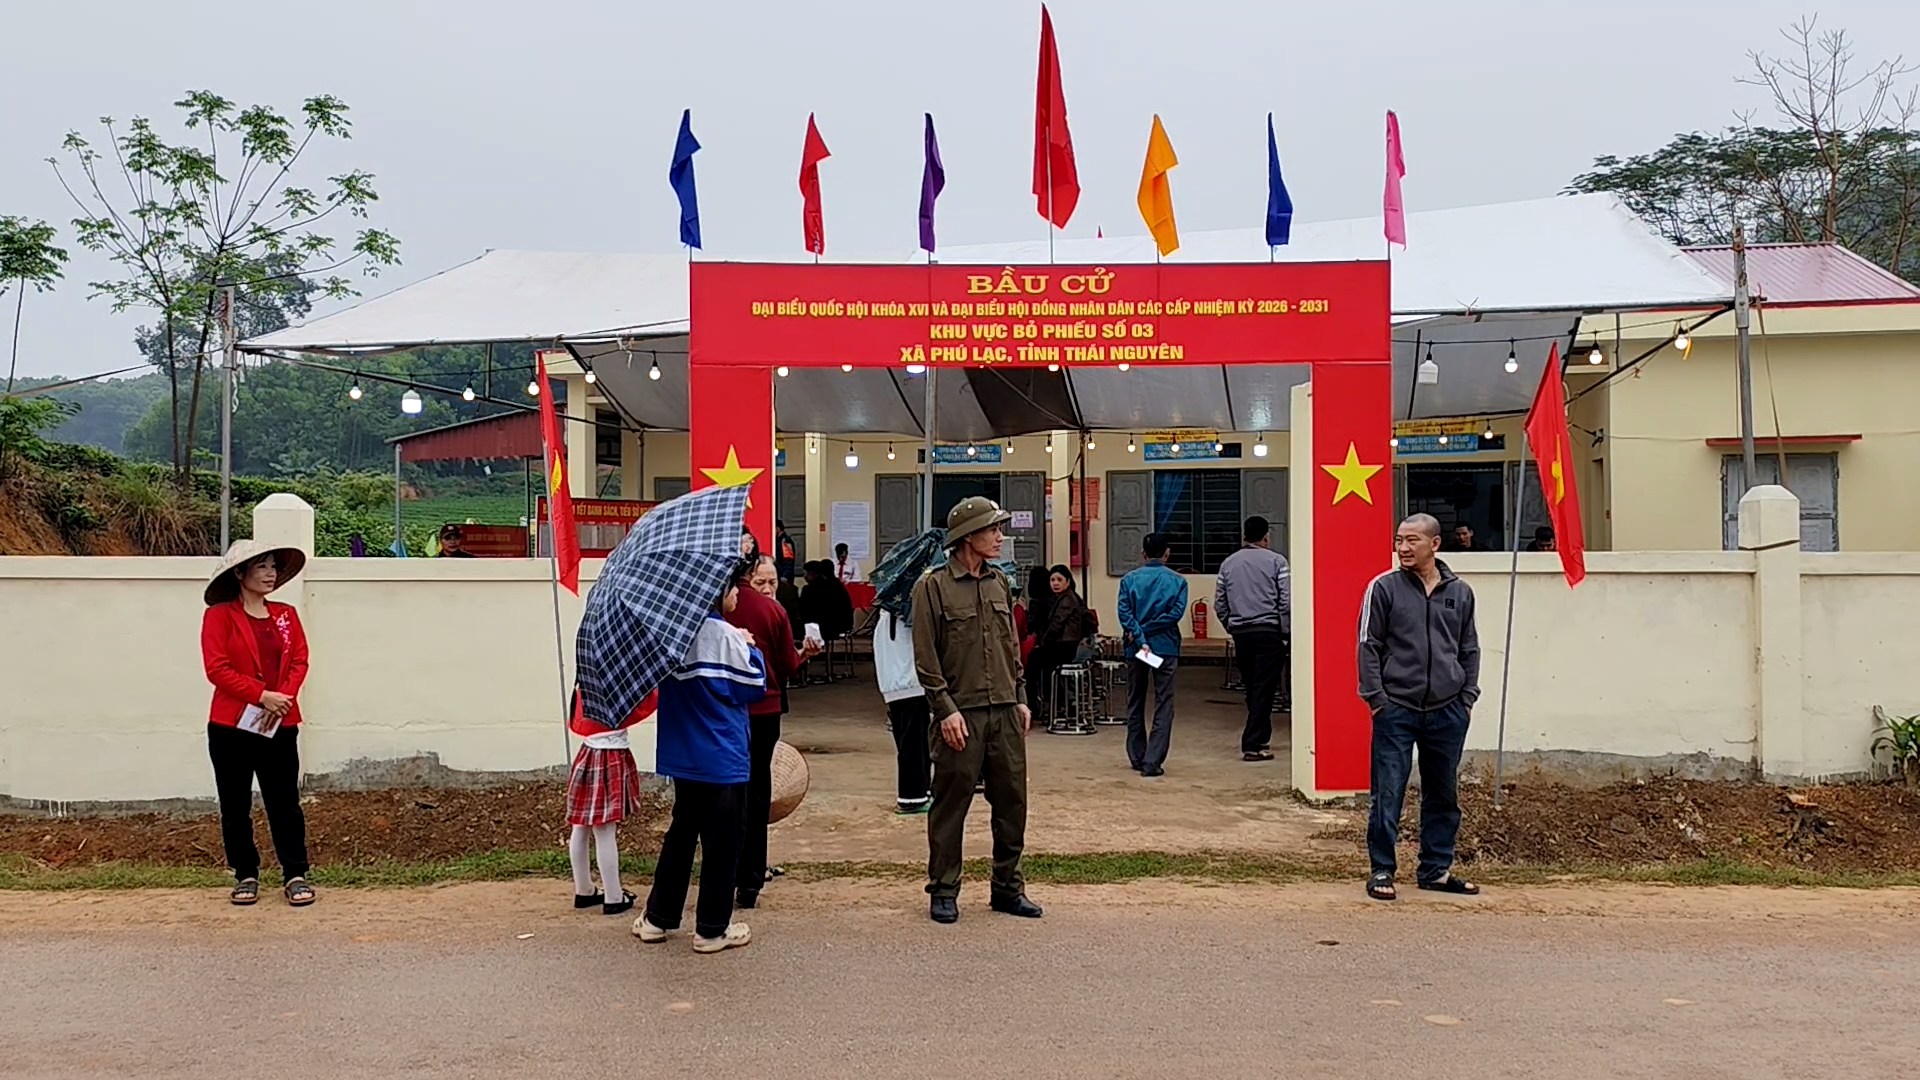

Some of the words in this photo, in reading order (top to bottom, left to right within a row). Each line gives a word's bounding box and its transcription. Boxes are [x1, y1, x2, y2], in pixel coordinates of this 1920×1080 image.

[967, 266, 1049, 294] BẦU
[1060, 267, 1115, 294] CỬ
[752, 302, 774, 317] ĐẠI
[777, 298, 806, 316] BIỂU
[809, 299, 843, 317] QUỐC
[847, 301, 868, 319] HỘI
[871, 301, 905, 316] KHÓA
[908, 304, 929, 316] XVI
[932, 301, 949, 316] VÀ
[952, 303, 973, 318] ĐẠI
[976, 298, 1005, 316] BIỂU
[1008, 303, 1029, 318] HỘI
[1069, 301, 1105, 316] NHÂN
[1108, 300, 1135, 316] DÂN
[1138, 300, 1162, 315] CÁC
[1165, 298, 1191, 315] CẤP
[1194, 299, 1235, 317] NHIỆM
[1238, 298, 1254, 313] KỲ
[1257, 300, 1288, 313] 2026
[1299, 300, 1329, 313] 2031
[930, 324, 967, 339] KHU
[972, 324, 1008, 342] VỰC
[1013, 320, 1038, 339] BỎ
[1042, 320, 1097, 338] PHIẾU
[1102, 319, 1127, 338] SỐ
[1131, 323, 1154, 338] 03
[900, 345, 926, 362] XÃ
[931, 344, 968, 361] PHÚ
[973, 347, 1013, 364] LẠC,
[1017, 342, 1060, 361] TỈNH
[1064, 343, 1105, 361] THÁI
[1110, 343, 1184, 361] NGUYÊN
